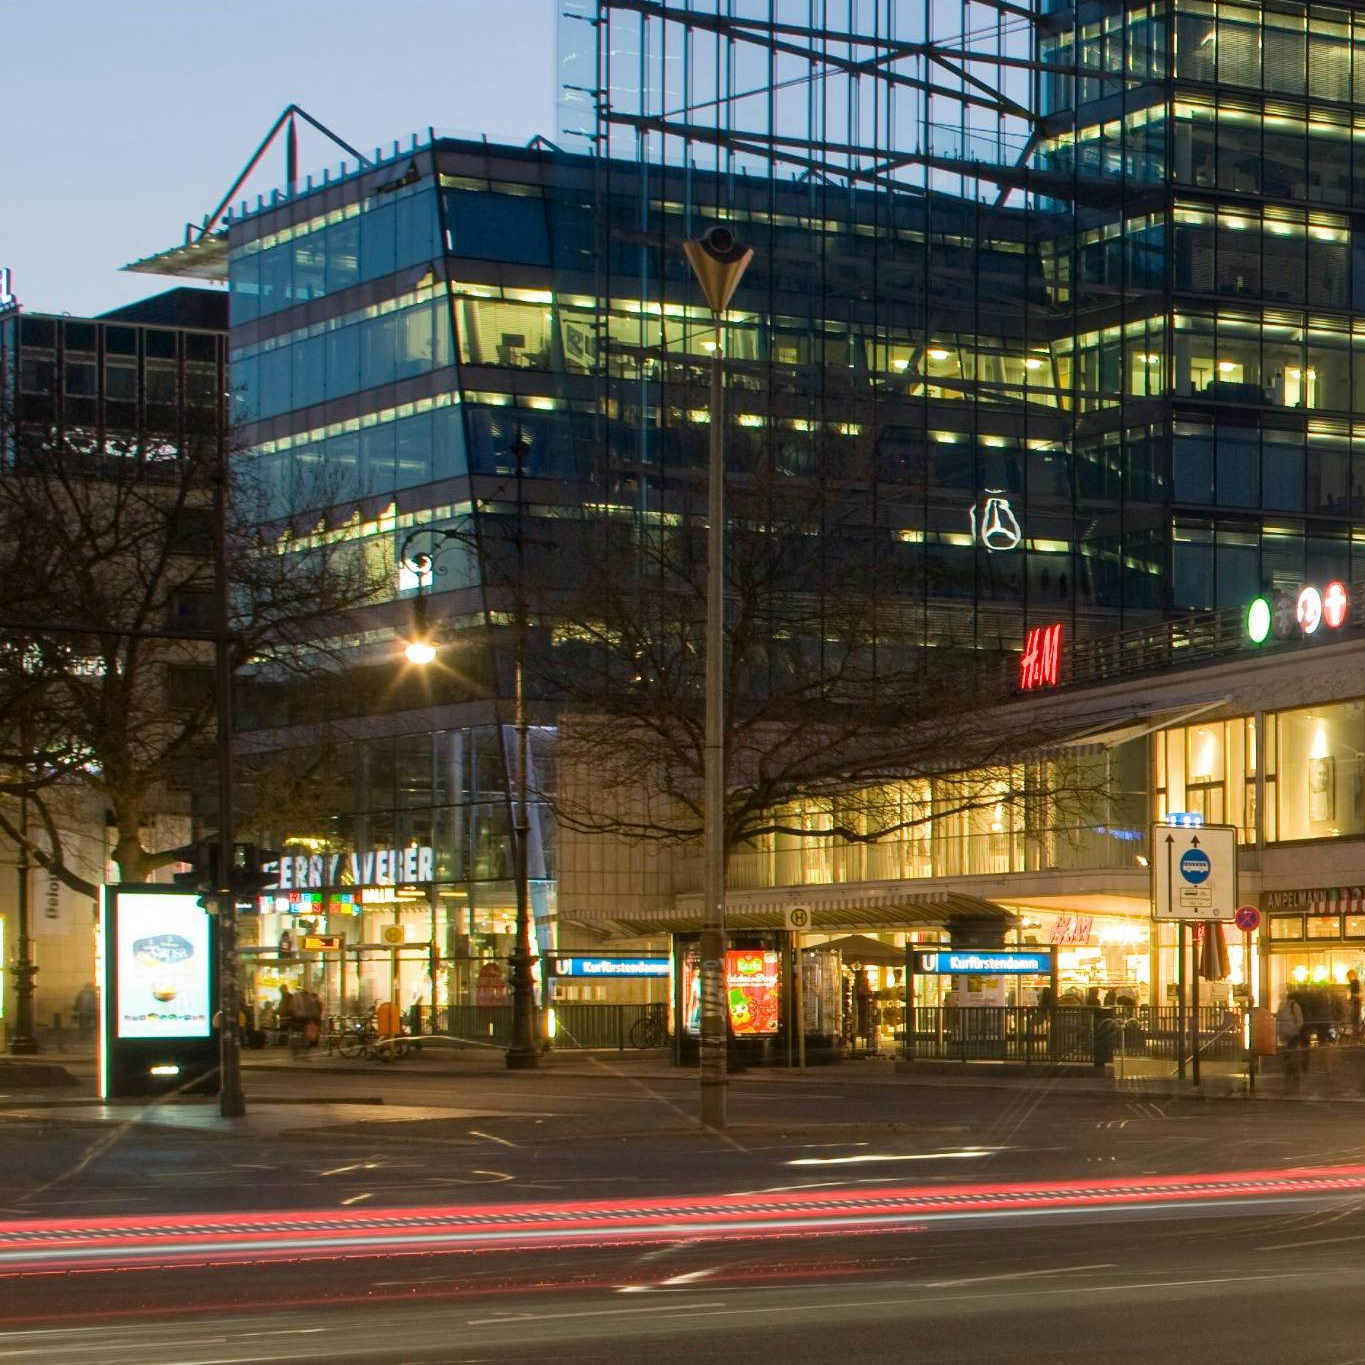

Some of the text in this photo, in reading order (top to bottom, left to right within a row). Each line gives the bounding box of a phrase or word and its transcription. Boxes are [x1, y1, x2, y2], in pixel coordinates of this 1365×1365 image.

[1020, 624, 1062, 689] H&M
[352, 847, 432, 885] WEBER
[556, 959, 569, 975] U
[922, 954, 1039, 971] U Kurfürstendamm
